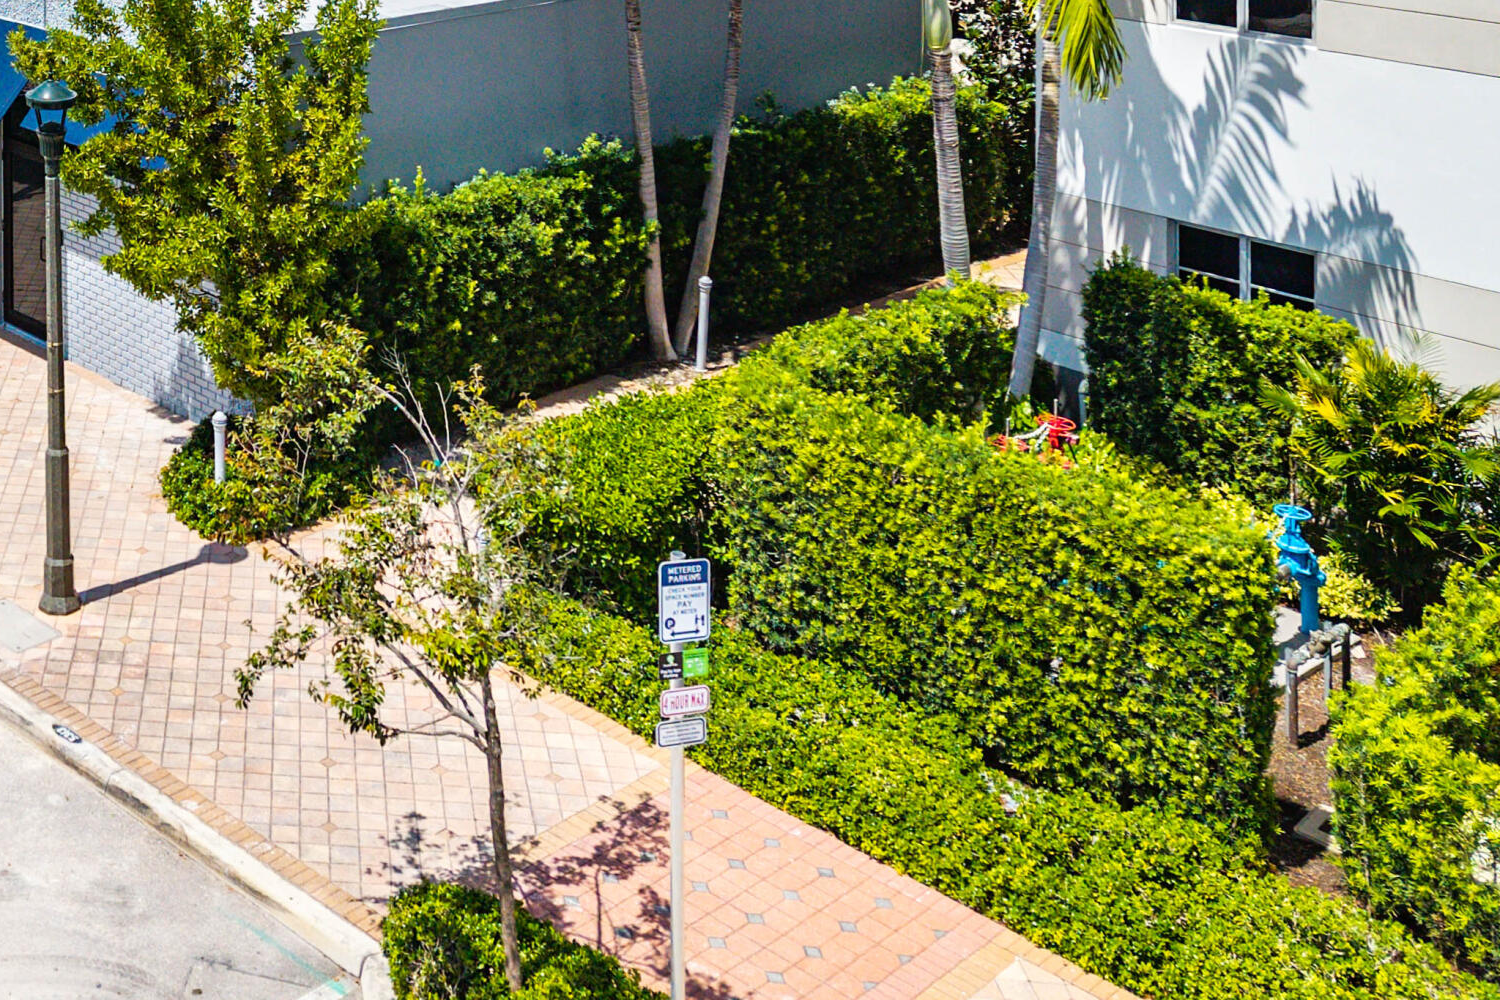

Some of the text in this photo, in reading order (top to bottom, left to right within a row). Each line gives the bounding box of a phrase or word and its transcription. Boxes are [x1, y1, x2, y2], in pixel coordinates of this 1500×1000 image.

[667, 564, 702, 575] METERED
[668, 573, 702, 584] PARKING
[677, 600, 692, 608] PAY
[670, 694, 689, 711] HOUR
[691, 691, 705, 707] MAX
